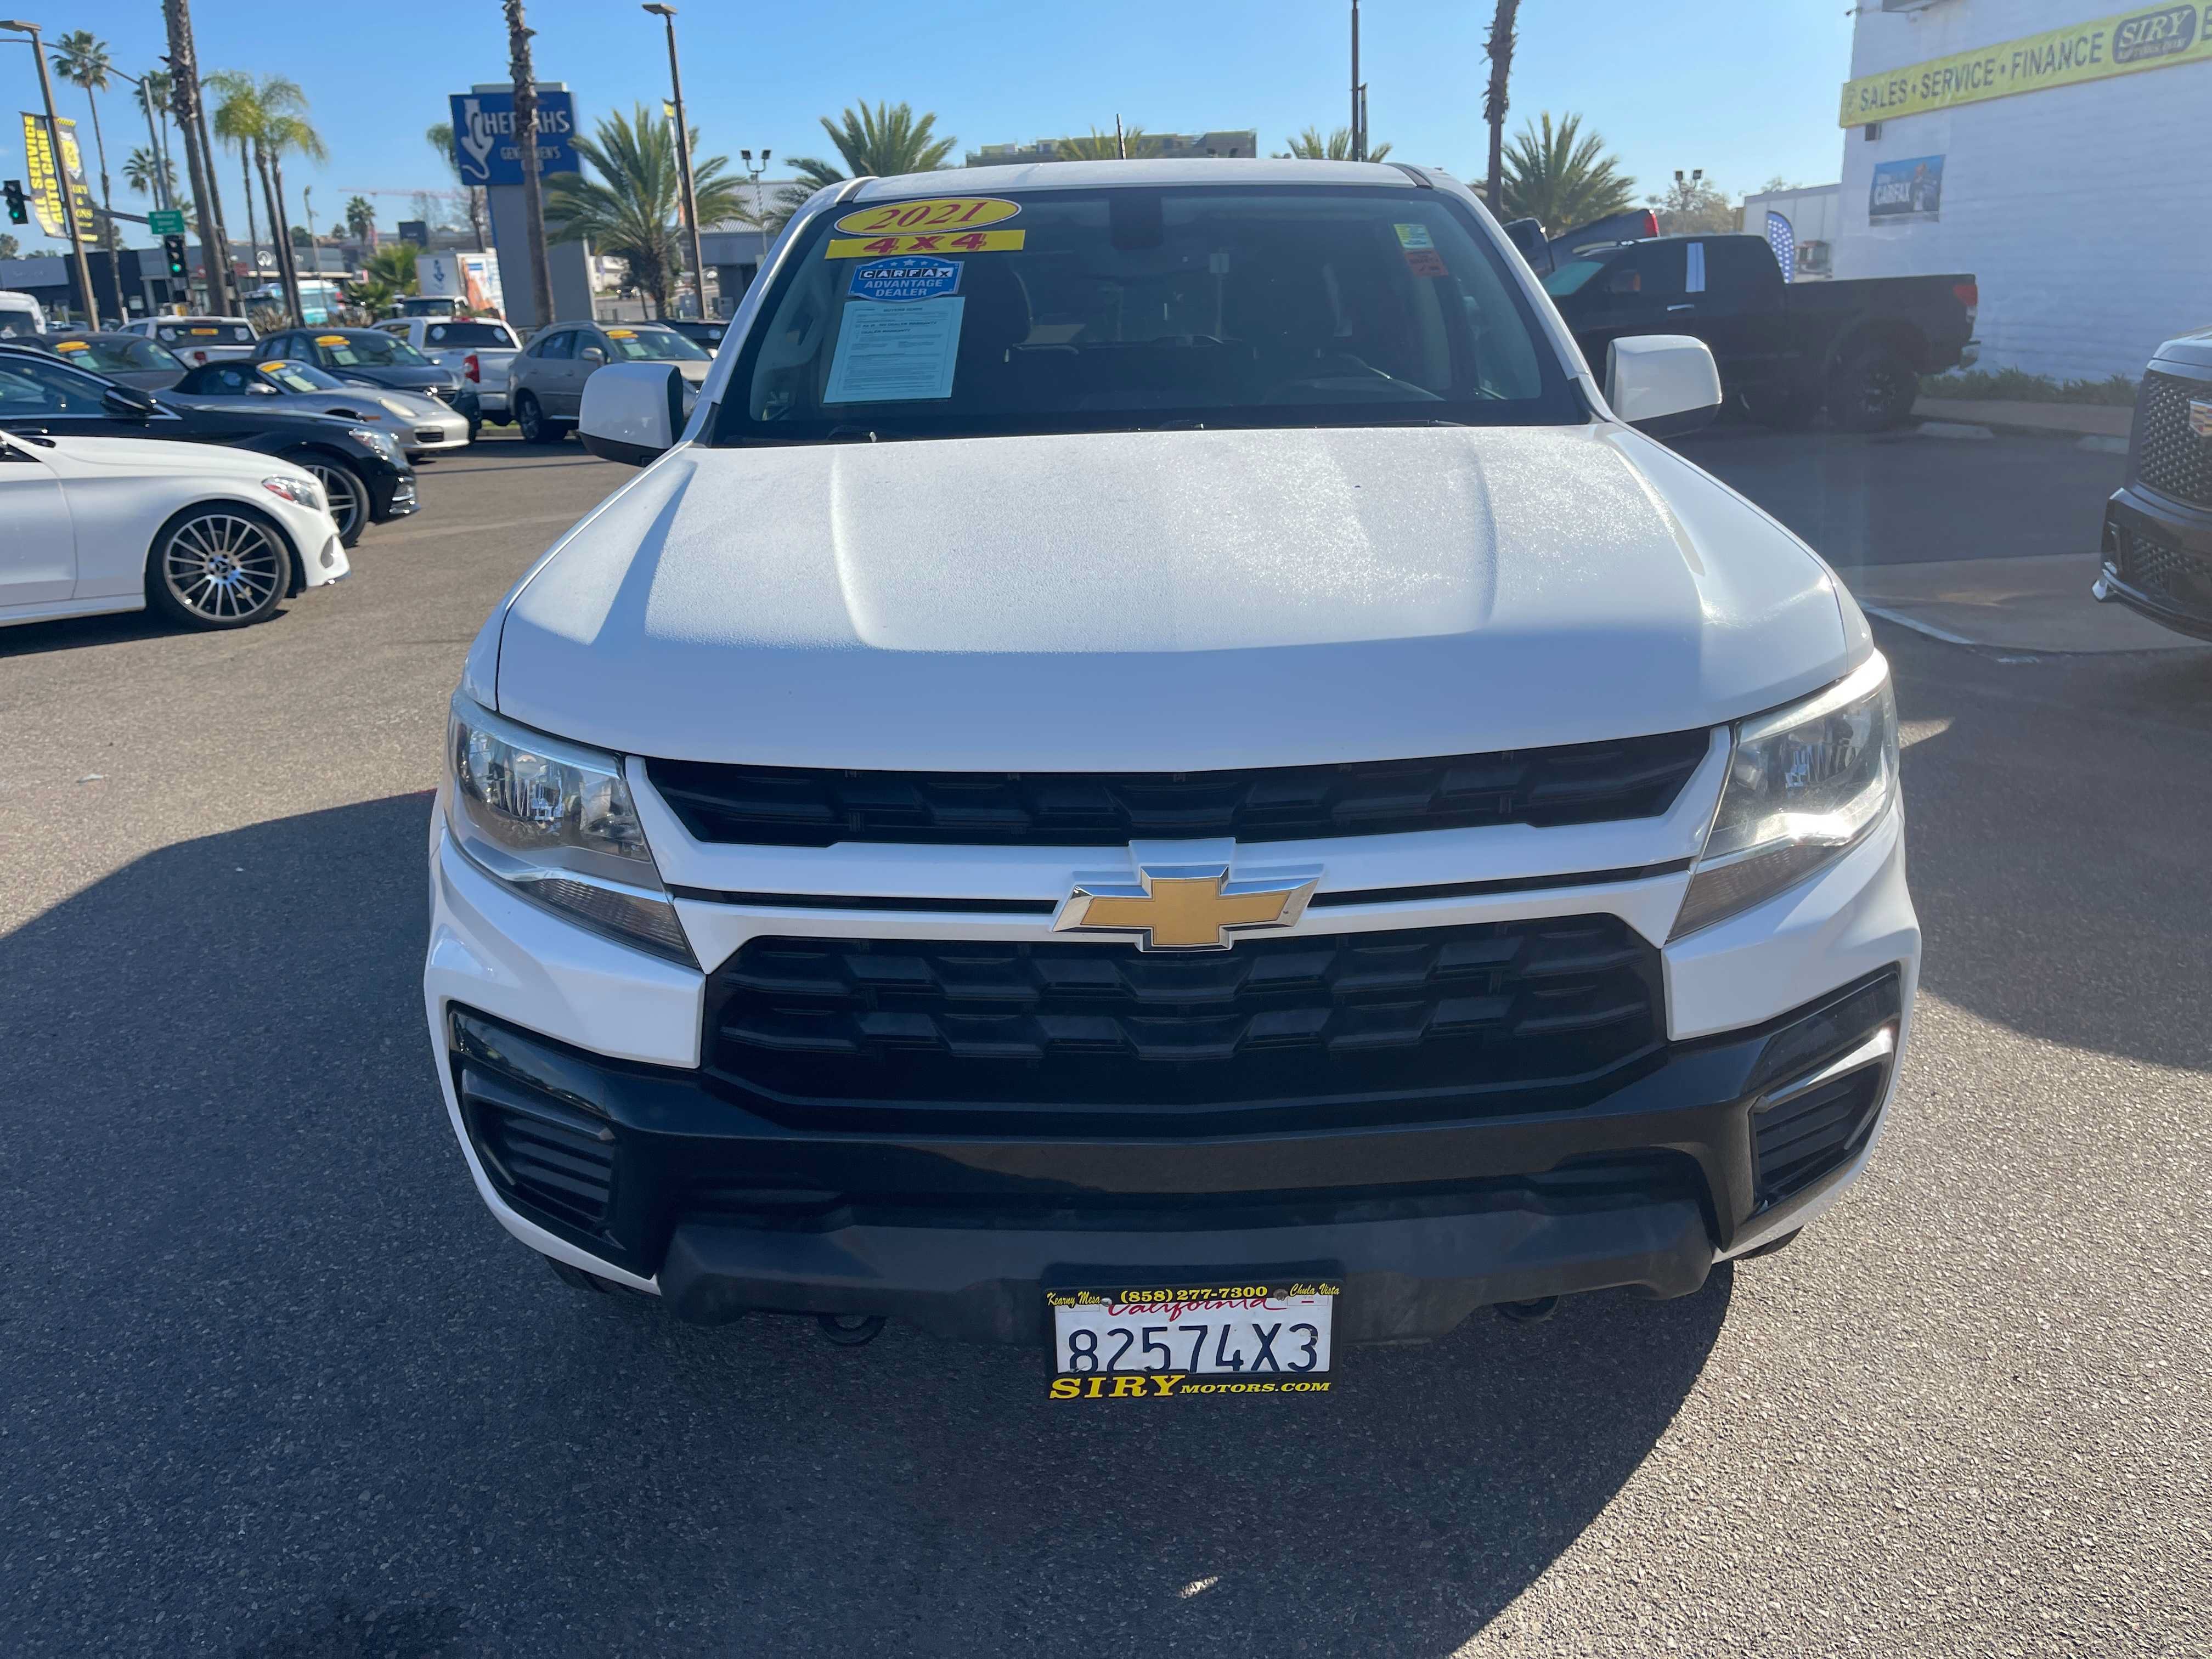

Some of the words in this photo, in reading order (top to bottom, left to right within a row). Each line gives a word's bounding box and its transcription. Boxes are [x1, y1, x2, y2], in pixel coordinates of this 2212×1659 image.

[2119, 9, 2192, 47] SIRY
[1860, 78, 1908, 111] SALES
[1921, 58, 1995, 99] SERVICE
[2011, 31, 2104, 79] FINANCE
[24, 115, 44, 189] SERVICE
[36, 129, 54, 175] CARE
[44, 178, 65, 225] AUTO
[864, 201, 989, 230] 2021
[860, 267, 953, 280] CARFAX
[864, 279, 943, 289] ADVANTAGE
[875, 287, 927, 297] DEALER
[1047, 1292, 1075, 1308] Kearny
[1078, 1291, 1101, 1305] Mesa
[1290, 1283, 1316, 1295] Chula
[1318, 1283, 1340, 1295] Vista
[1069, 1323, 1318, 1372] 82574X3
